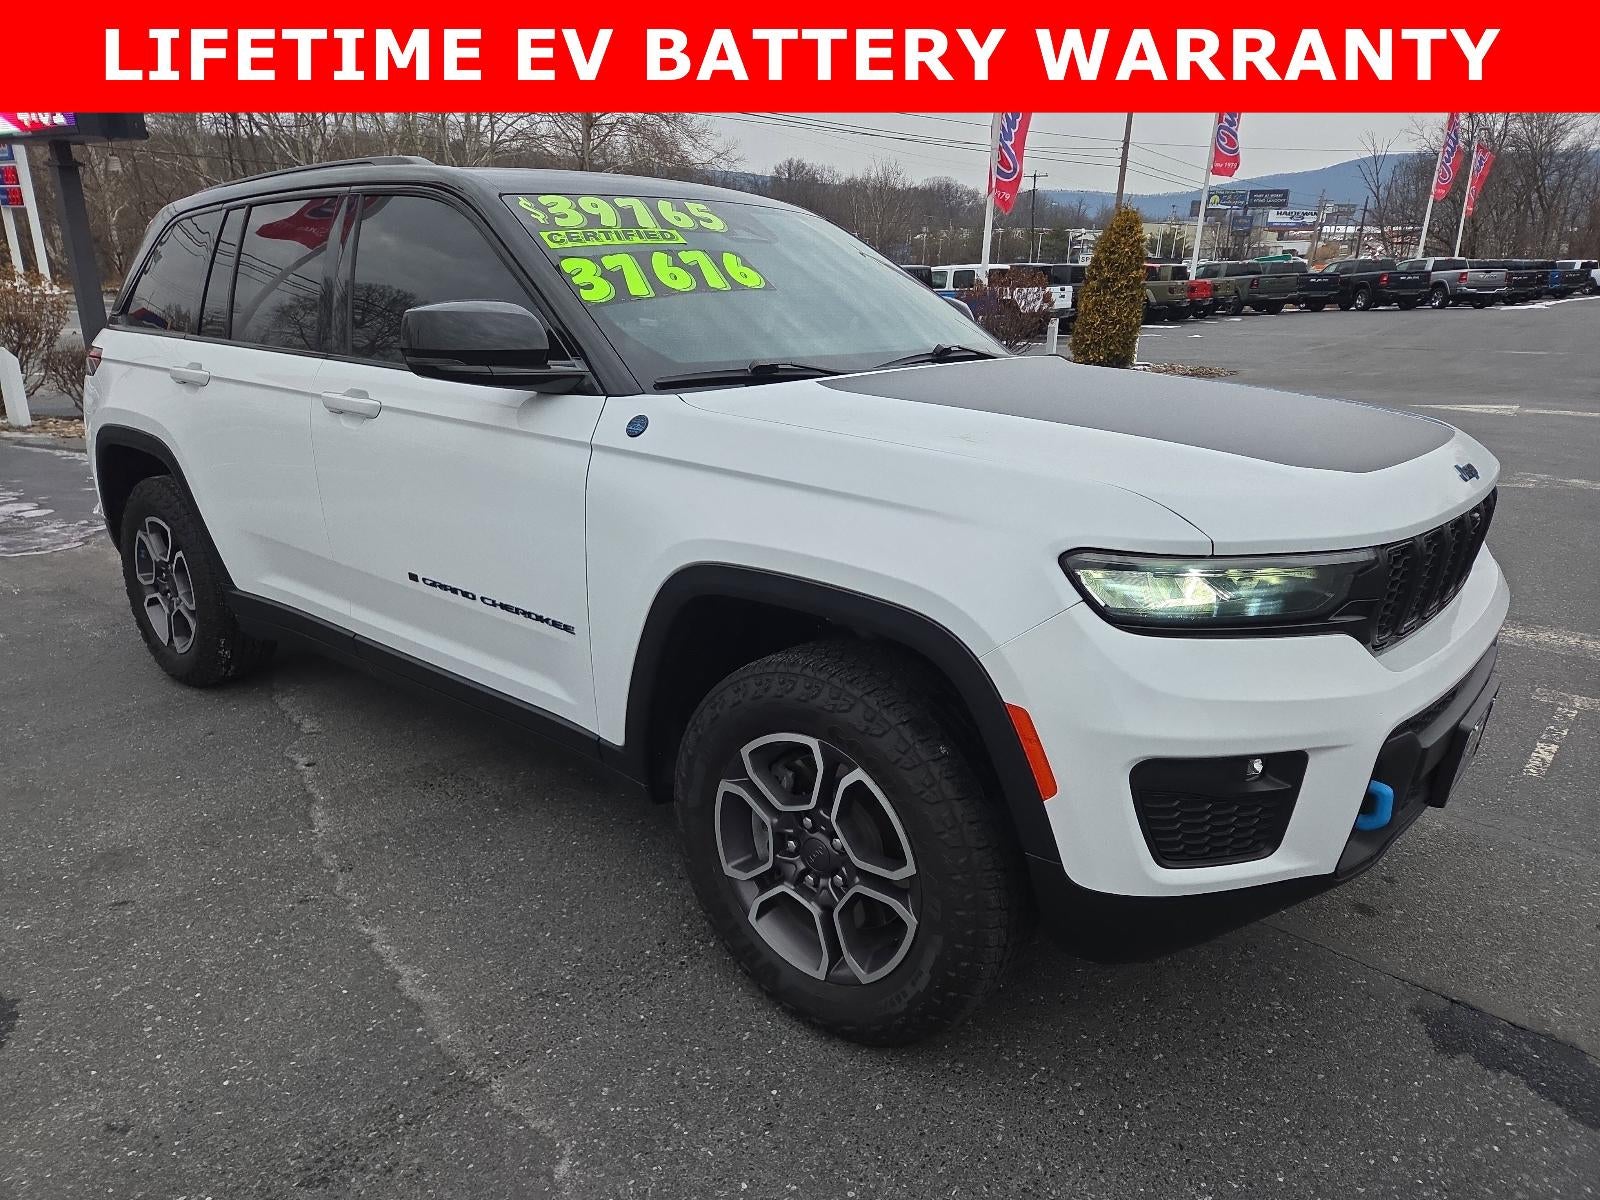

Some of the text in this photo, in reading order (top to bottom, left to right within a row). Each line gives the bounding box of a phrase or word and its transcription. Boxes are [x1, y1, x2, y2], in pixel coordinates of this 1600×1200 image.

[518, 194, 728, 233] $39765
[546, 229, 678, 245] CERTIFIED
[560, 249, 766, 304] 37676
[421, 577, 577, 636] GRAND CHEROKEE
